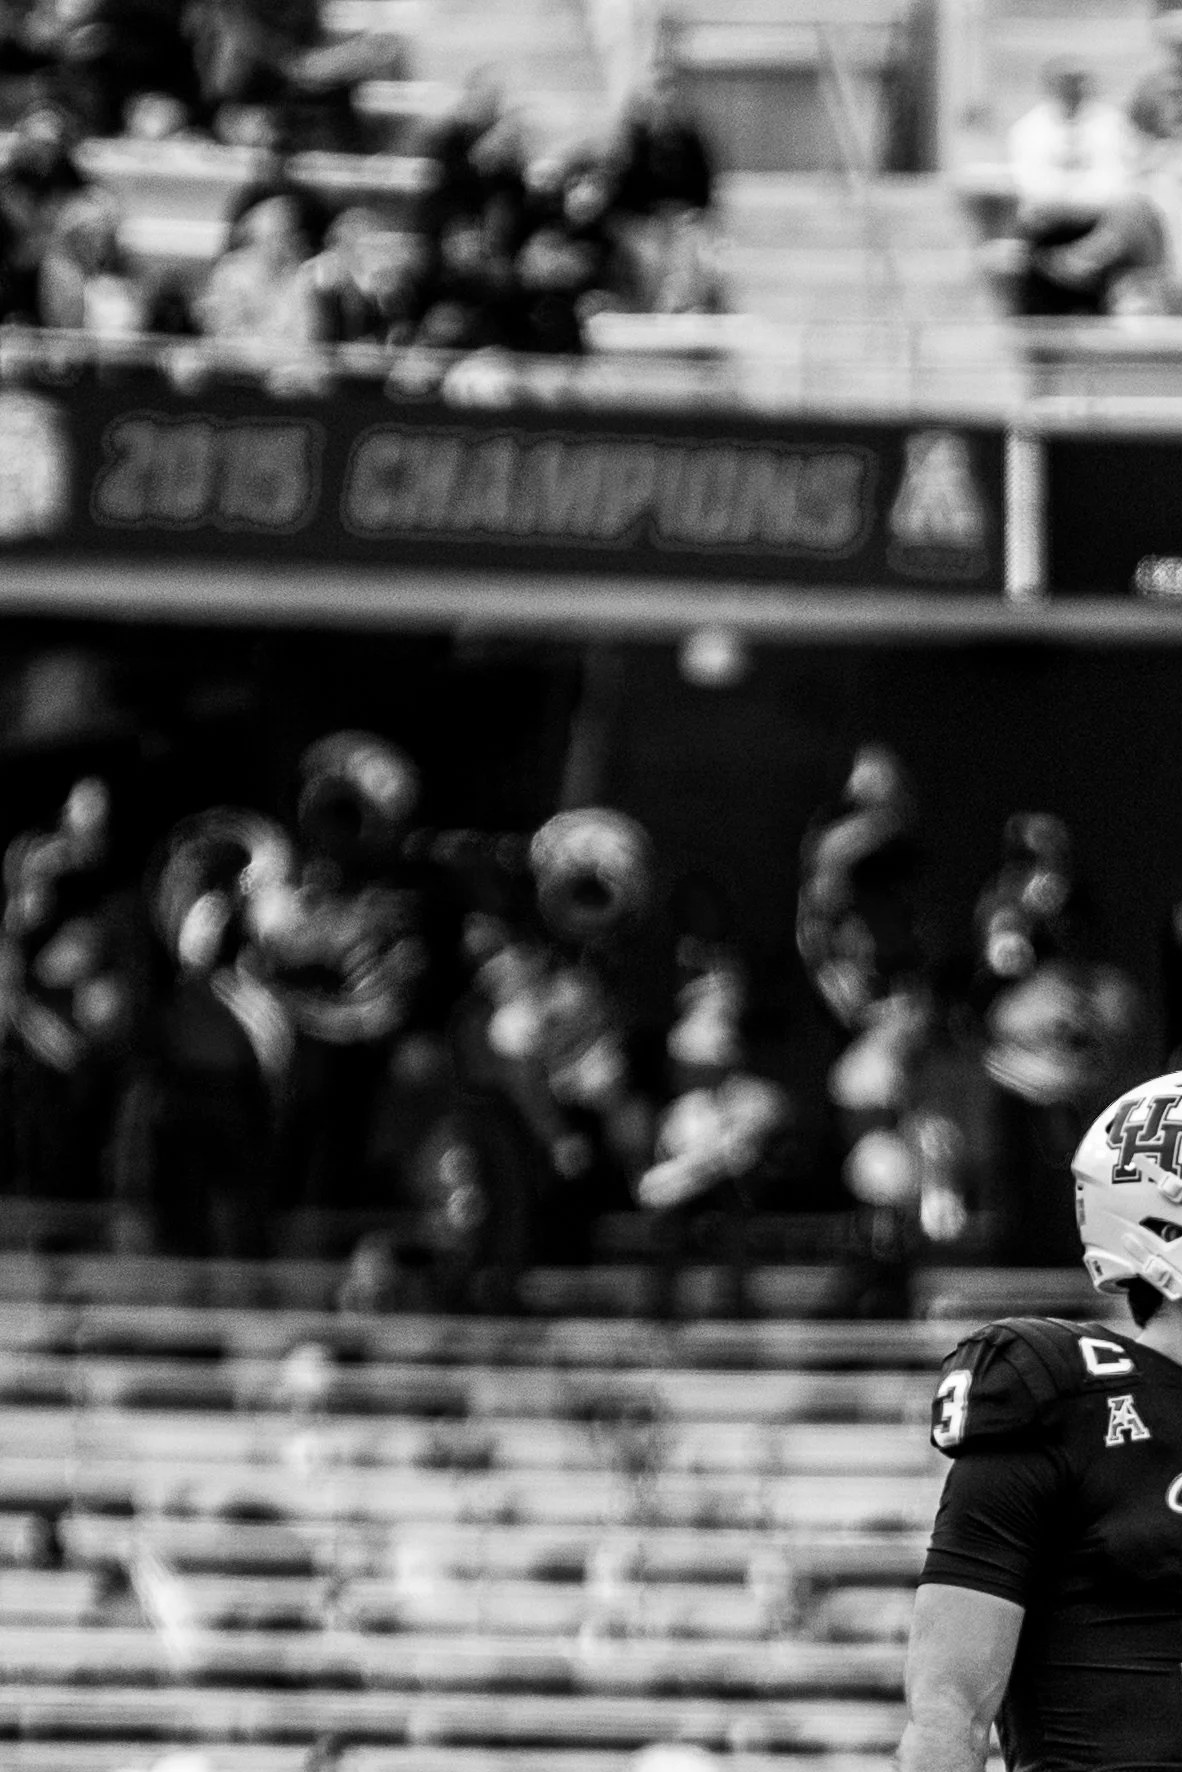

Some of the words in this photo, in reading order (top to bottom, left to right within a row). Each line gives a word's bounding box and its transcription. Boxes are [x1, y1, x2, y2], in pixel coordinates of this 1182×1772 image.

[94, 412, 322, 530] 2015
[342, 422, 876, 556] CHAMPIONS
[1079, 1338, 1134, 1376] C
[932, 1371, 972, 1447] 3
